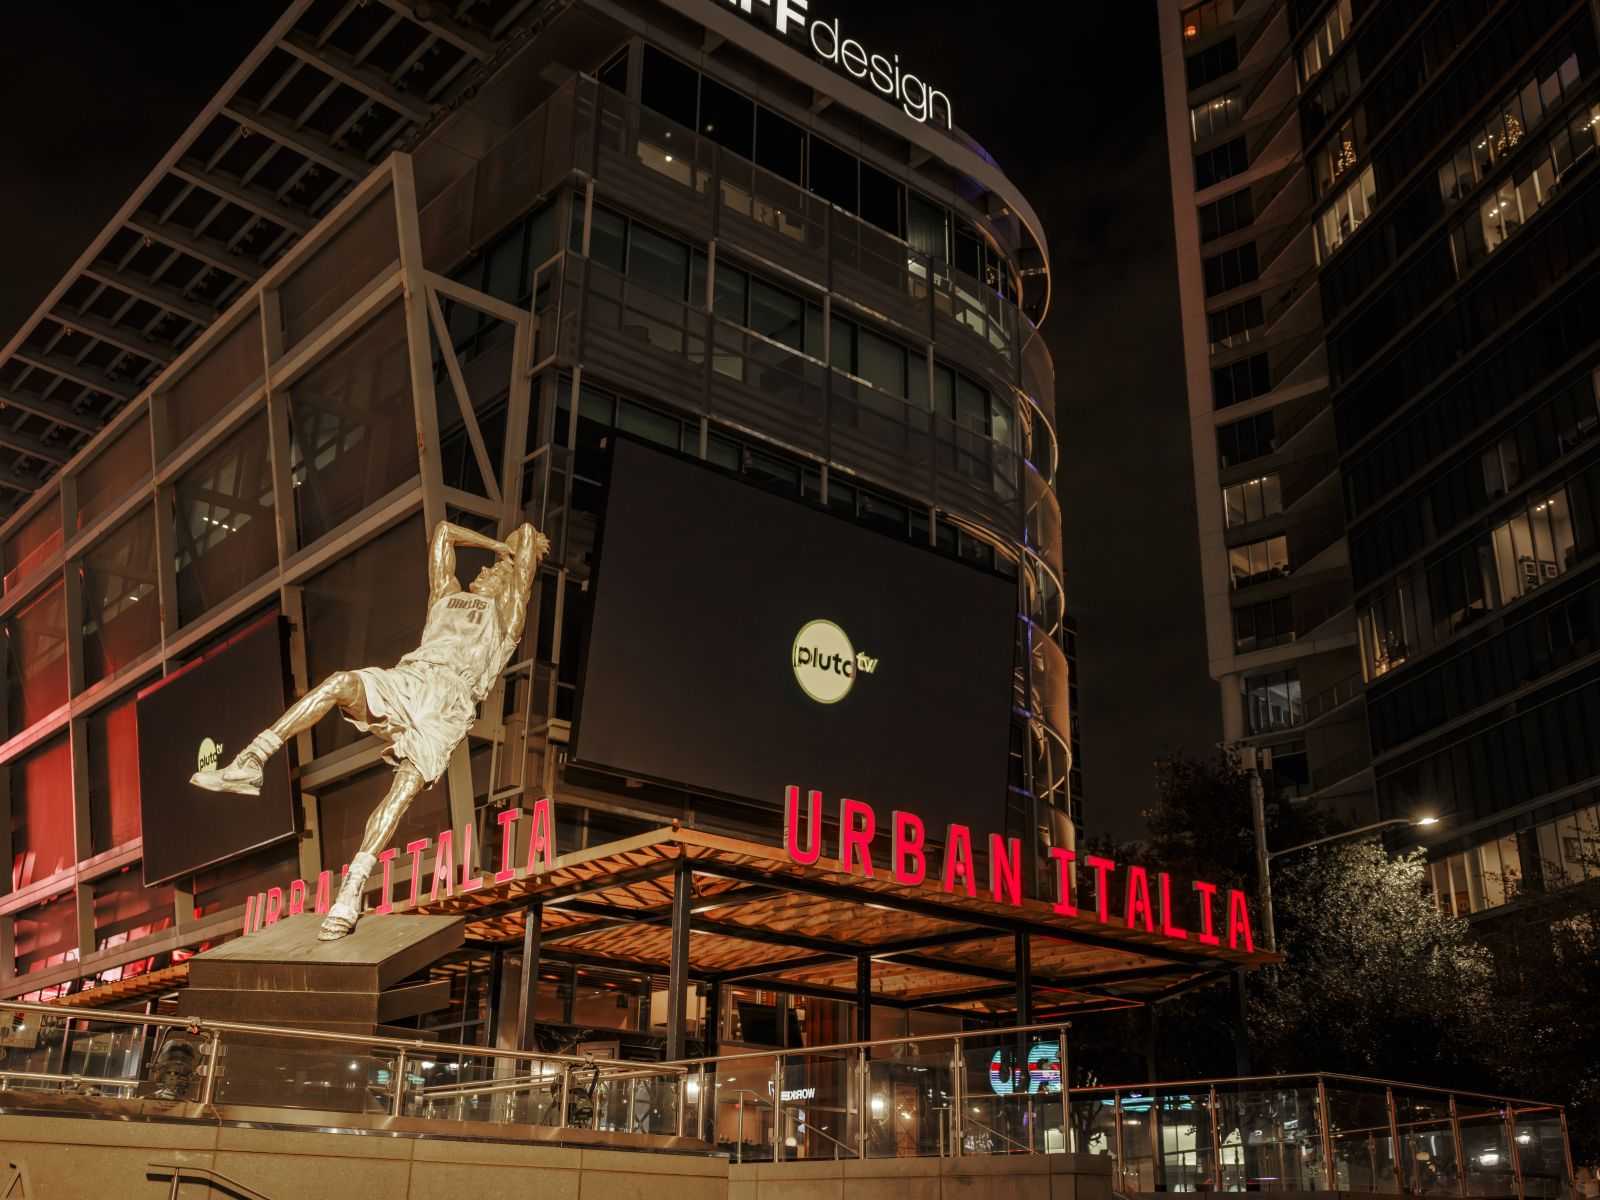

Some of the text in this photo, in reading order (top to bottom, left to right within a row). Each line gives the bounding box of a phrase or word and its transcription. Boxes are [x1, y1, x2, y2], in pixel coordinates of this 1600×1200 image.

[810, 18, 952, 129] design
[794, 646, 856, 679] pluto
[242, 798, 554, 937] URBA ITALIA
[784, 785, 1255, 953] URBAN ITALIA
